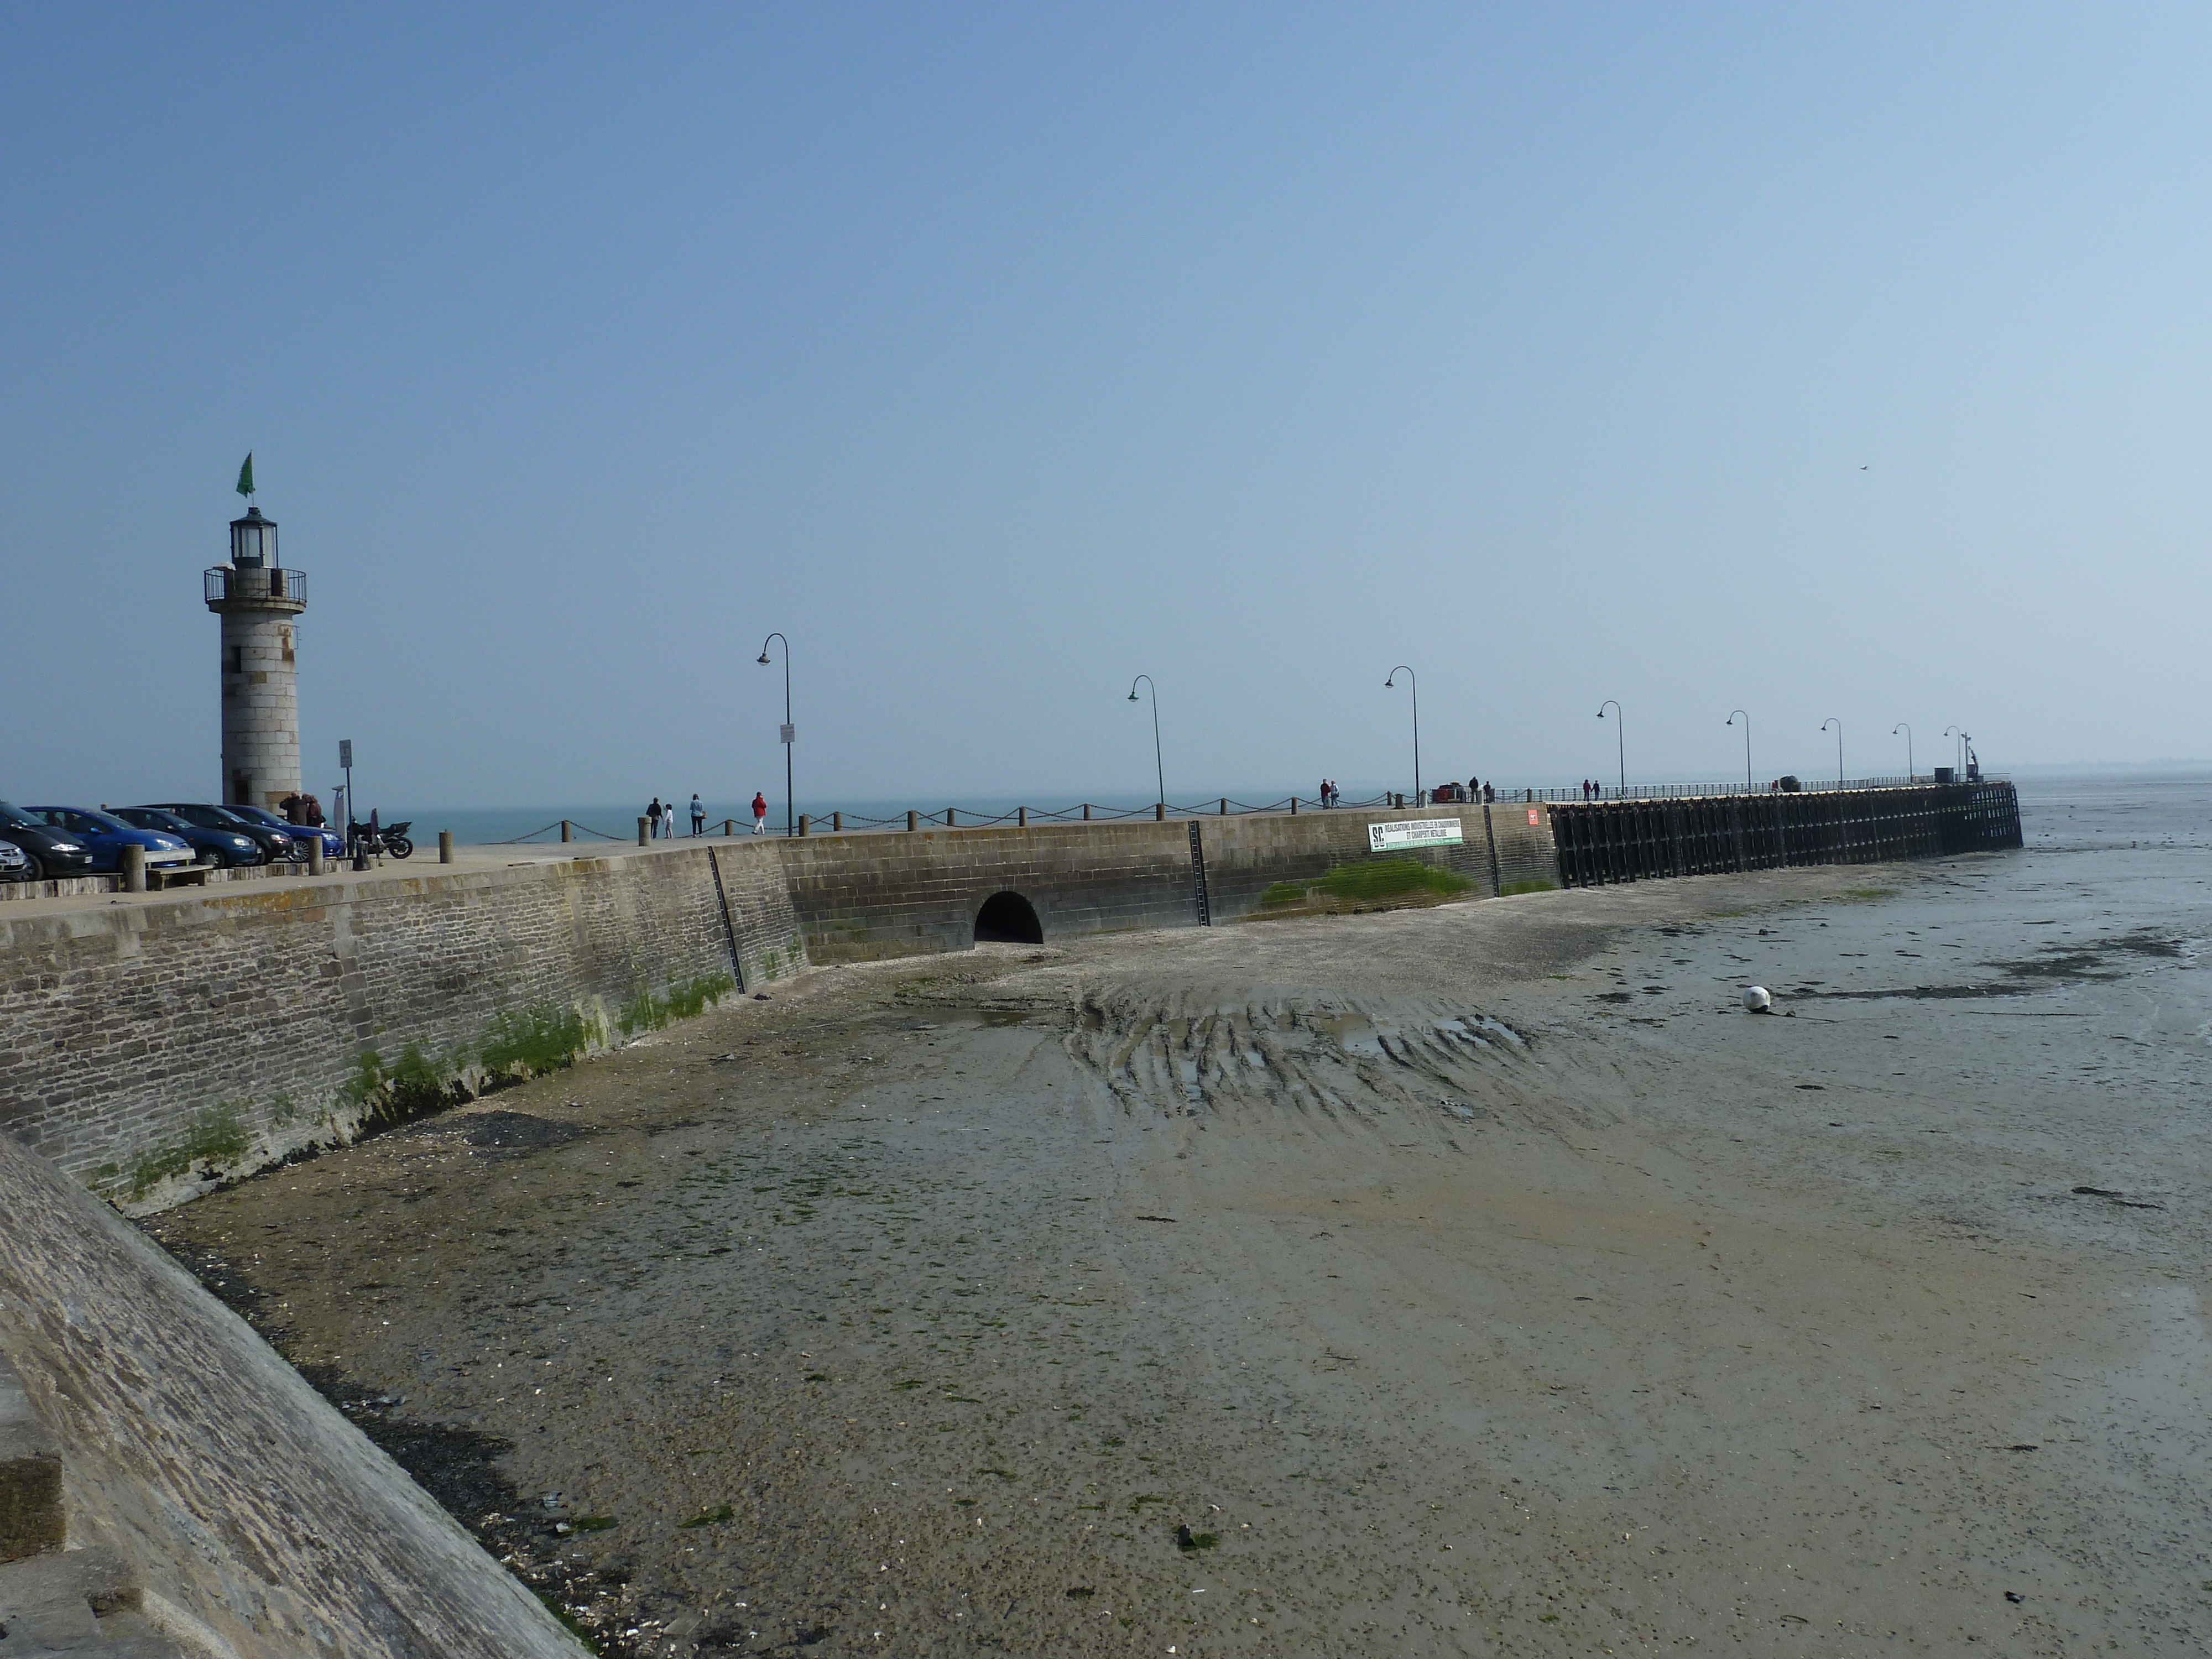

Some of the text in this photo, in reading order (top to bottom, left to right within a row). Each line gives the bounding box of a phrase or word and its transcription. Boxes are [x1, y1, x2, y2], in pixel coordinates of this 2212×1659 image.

[1385, 823, 1410, 832] RÉALISATIONS
[1406, 832, 1411, 840] ET
[1411, 830, 1430, 839] CHARPENTE
